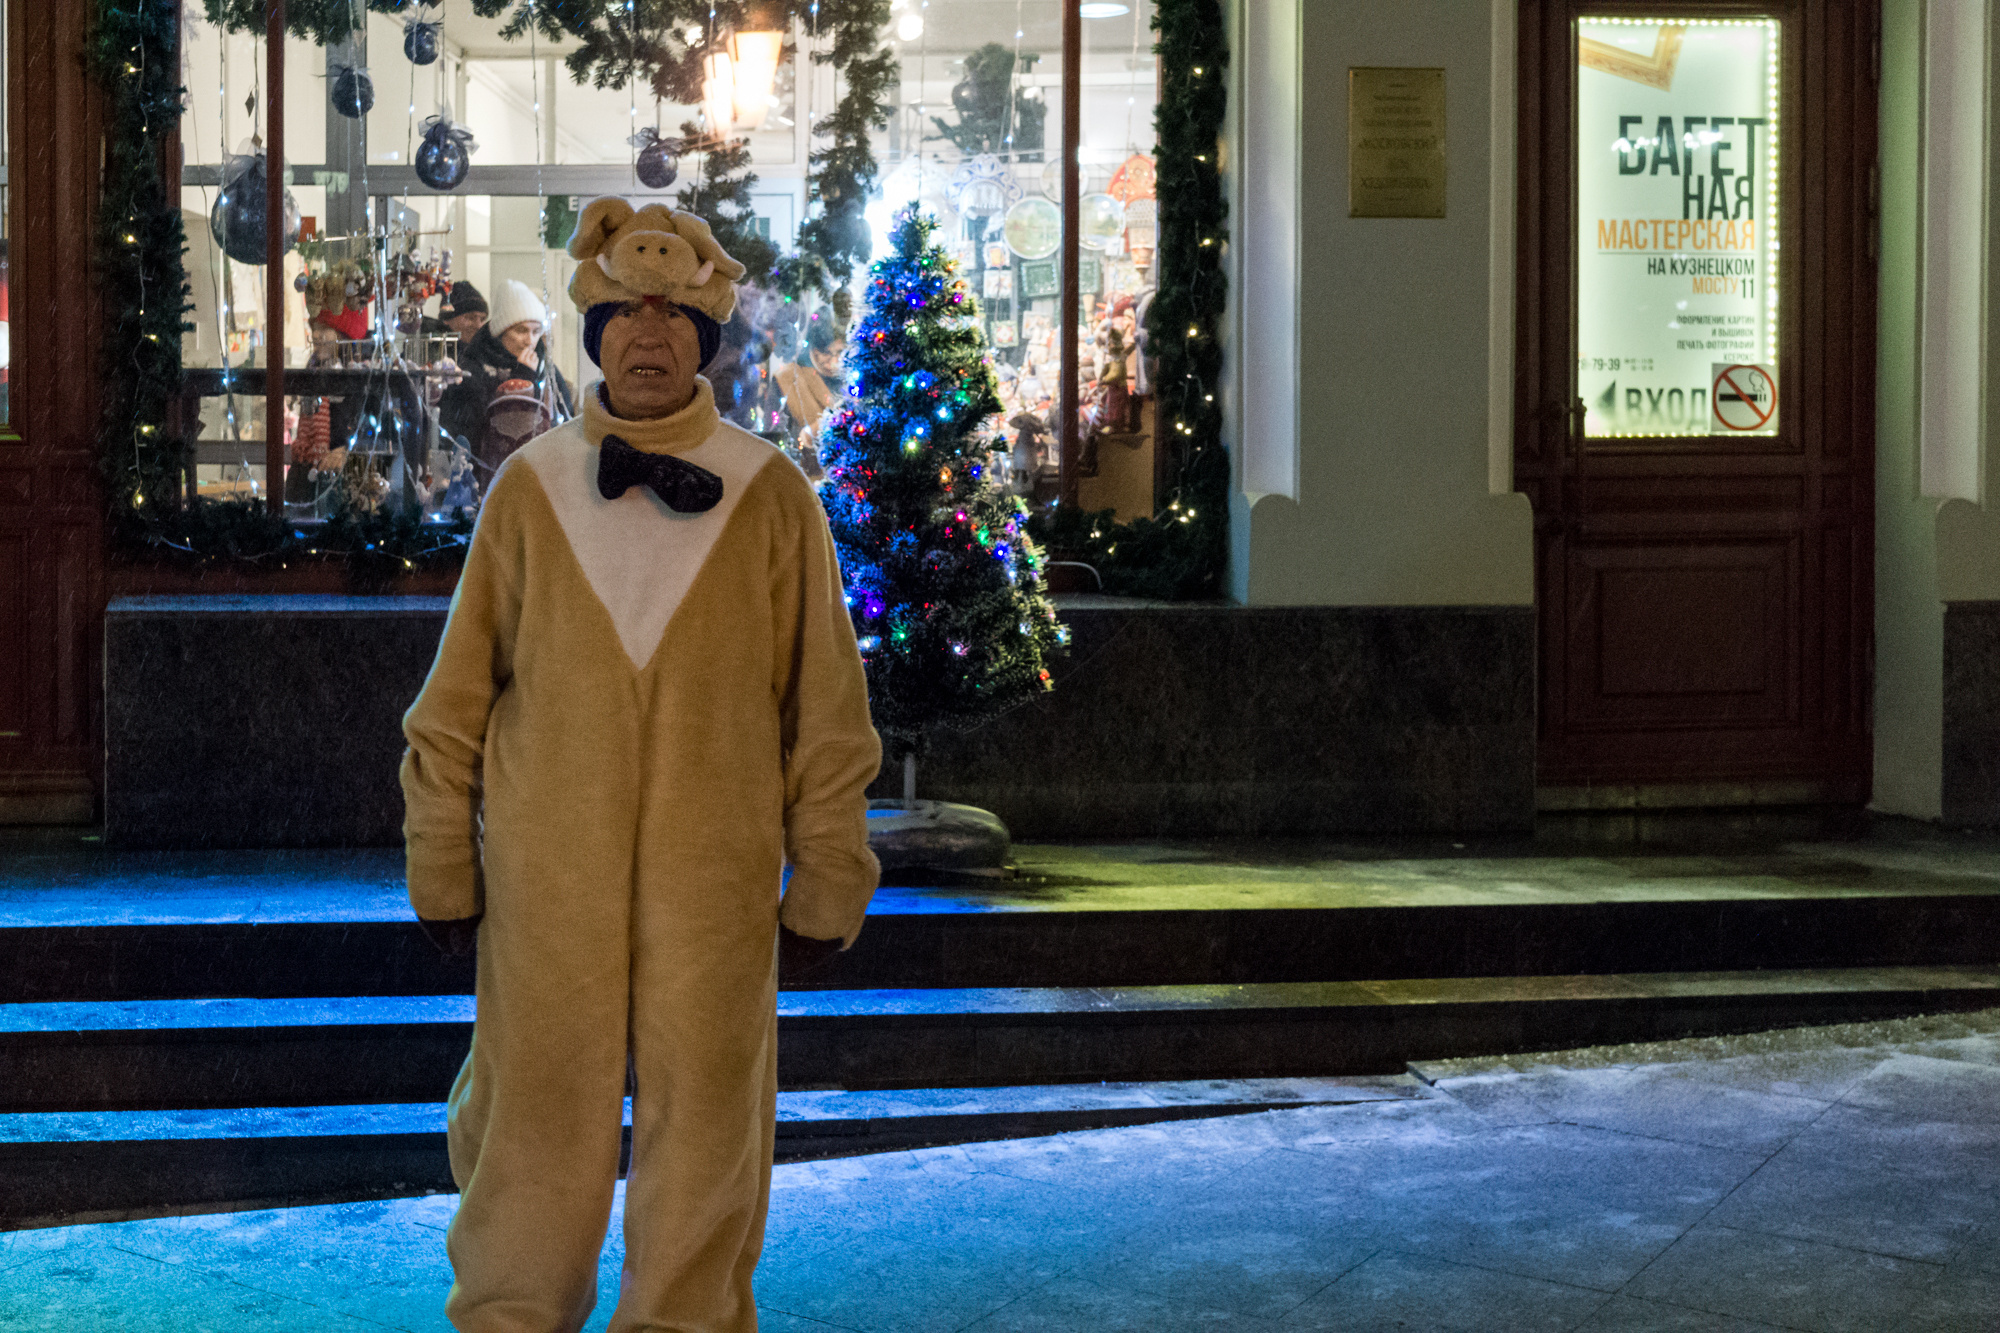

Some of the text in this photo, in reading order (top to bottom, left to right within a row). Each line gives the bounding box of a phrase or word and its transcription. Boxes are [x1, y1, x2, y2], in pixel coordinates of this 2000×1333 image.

[1619, 115, 1765, 176] БАГЕТ
[1683, 174, 1755, 220] НАЯ
[1597, 219, 1755, 250] МАСТЕРСКАЯ
[1647, 257, 1754, 277] НА КУЗНЕЦКОМ
[1692, 277, 1754, 298] МОСТУ 11
[1676, 315, 1754, 325] ОФОРМЛЕНИЕ КАРТИН
[1676, 341, 1704, 350] ПЕЧАТЬ
[1625, 387, 1708, 430] ВХОД
